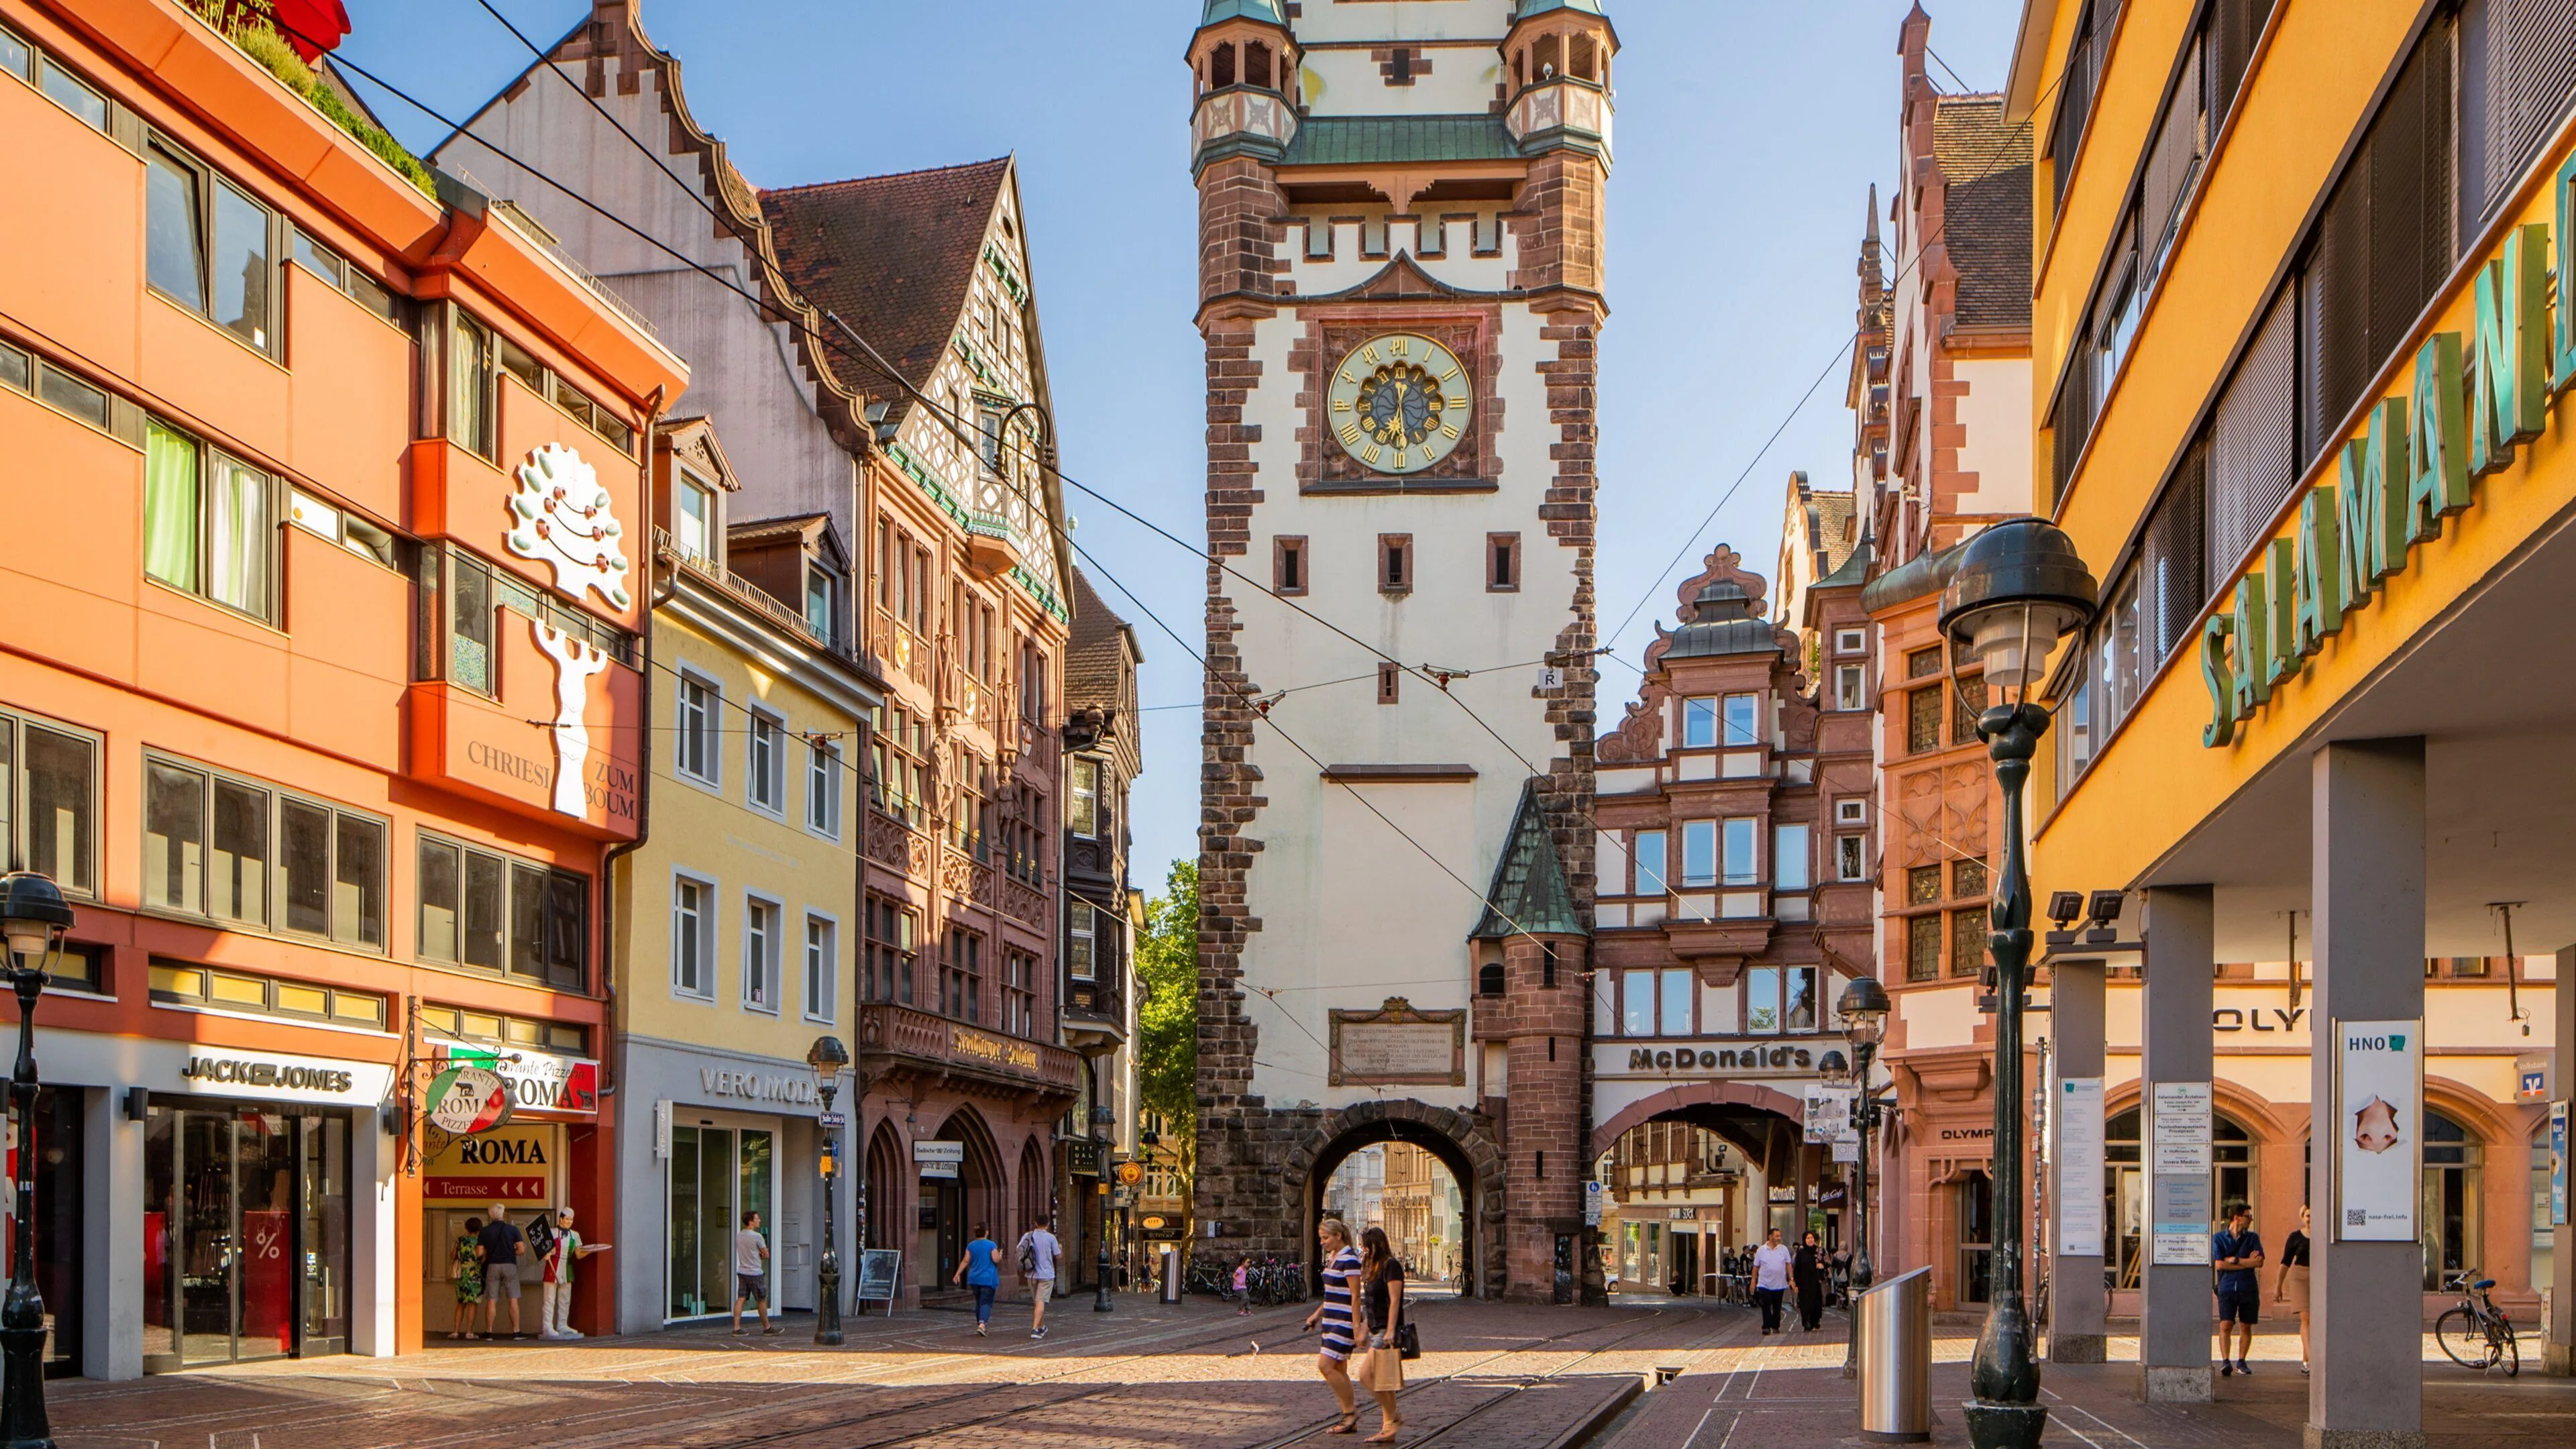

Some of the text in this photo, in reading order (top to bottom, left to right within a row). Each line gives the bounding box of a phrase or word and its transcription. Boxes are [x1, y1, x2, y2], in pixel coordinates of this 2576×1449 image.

[1546, 674, 1555, 685] R
[468, 741, 551, 790] CHRIESI
[595, 761, 635, 794] ZUM
[584, 782, 635, 821] BOUM
[2349, 1036, 2385, 1051] HNO
[1628, 1046, 1811, 1069] McDonald's
[2520, 1060, 2547, 1070] Volksbank
[274, 1066, 352, 1093] JONES
[433, 1069, 498, 1090] RISTORANTE
[542, 1061, 586, 1080] Pizzeria
[700, 1065, 822, 1106] VERO MODA
[437, 1097, 492, 1114] ROMA
[441, 1116, 489, 1130] PIZZERIA
[1941, 1129, 1994, 1139] OLYMP
[460, 1140, 547, 1165] ROMA
[441, 1181, 488, 1195] Terrasse
[256, 1232, 280, 1259] %
